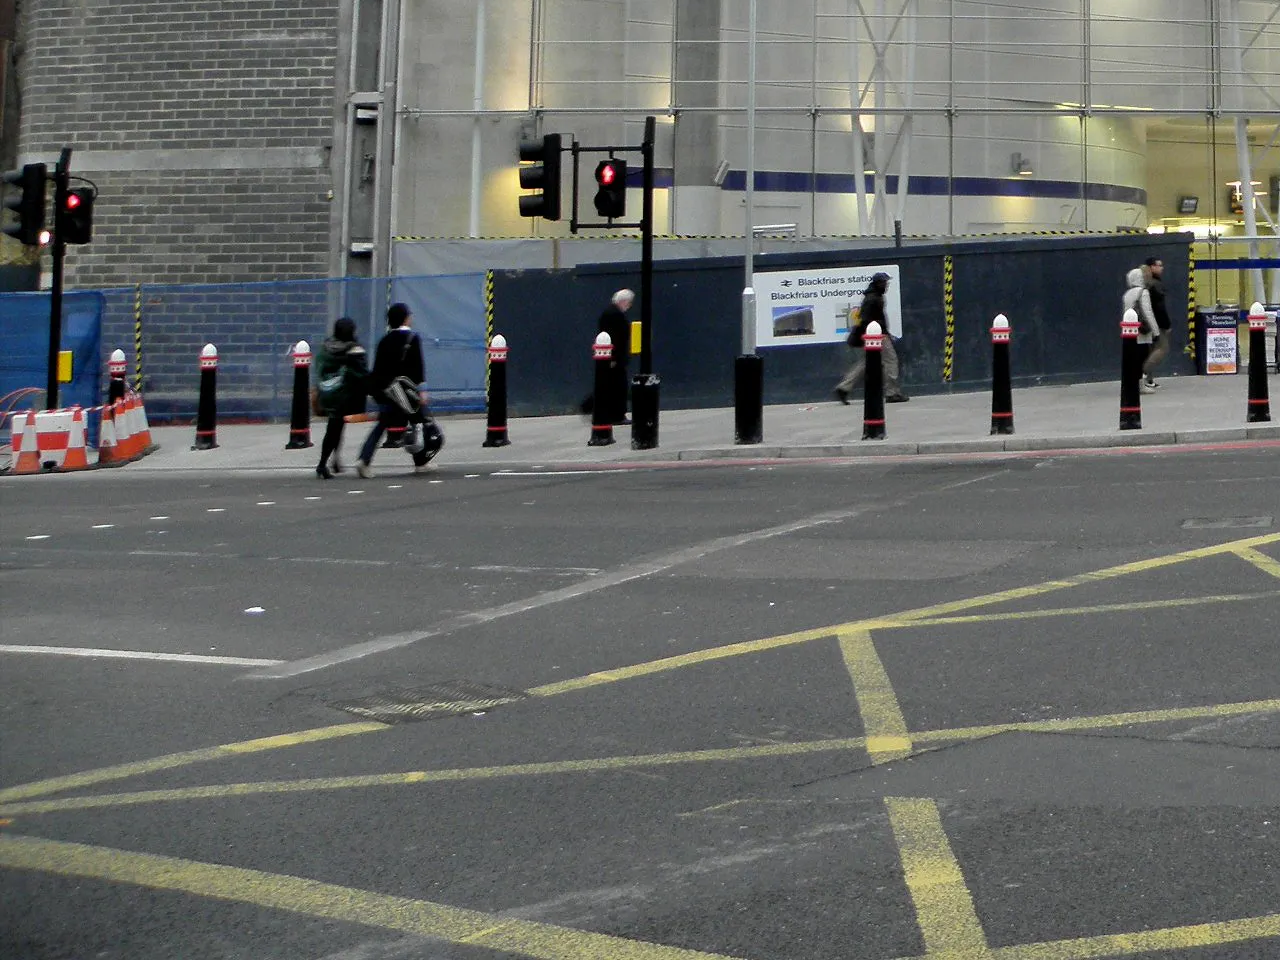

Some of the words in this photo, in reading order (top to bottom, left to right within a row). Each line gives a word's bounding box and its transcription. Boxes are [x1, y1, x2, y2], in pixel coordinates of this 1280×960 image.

[798, 277, 845, 287] Blackfriars
[847, 275, 873, 283] statio
[771, 290, 818, 301] Blackfriars
